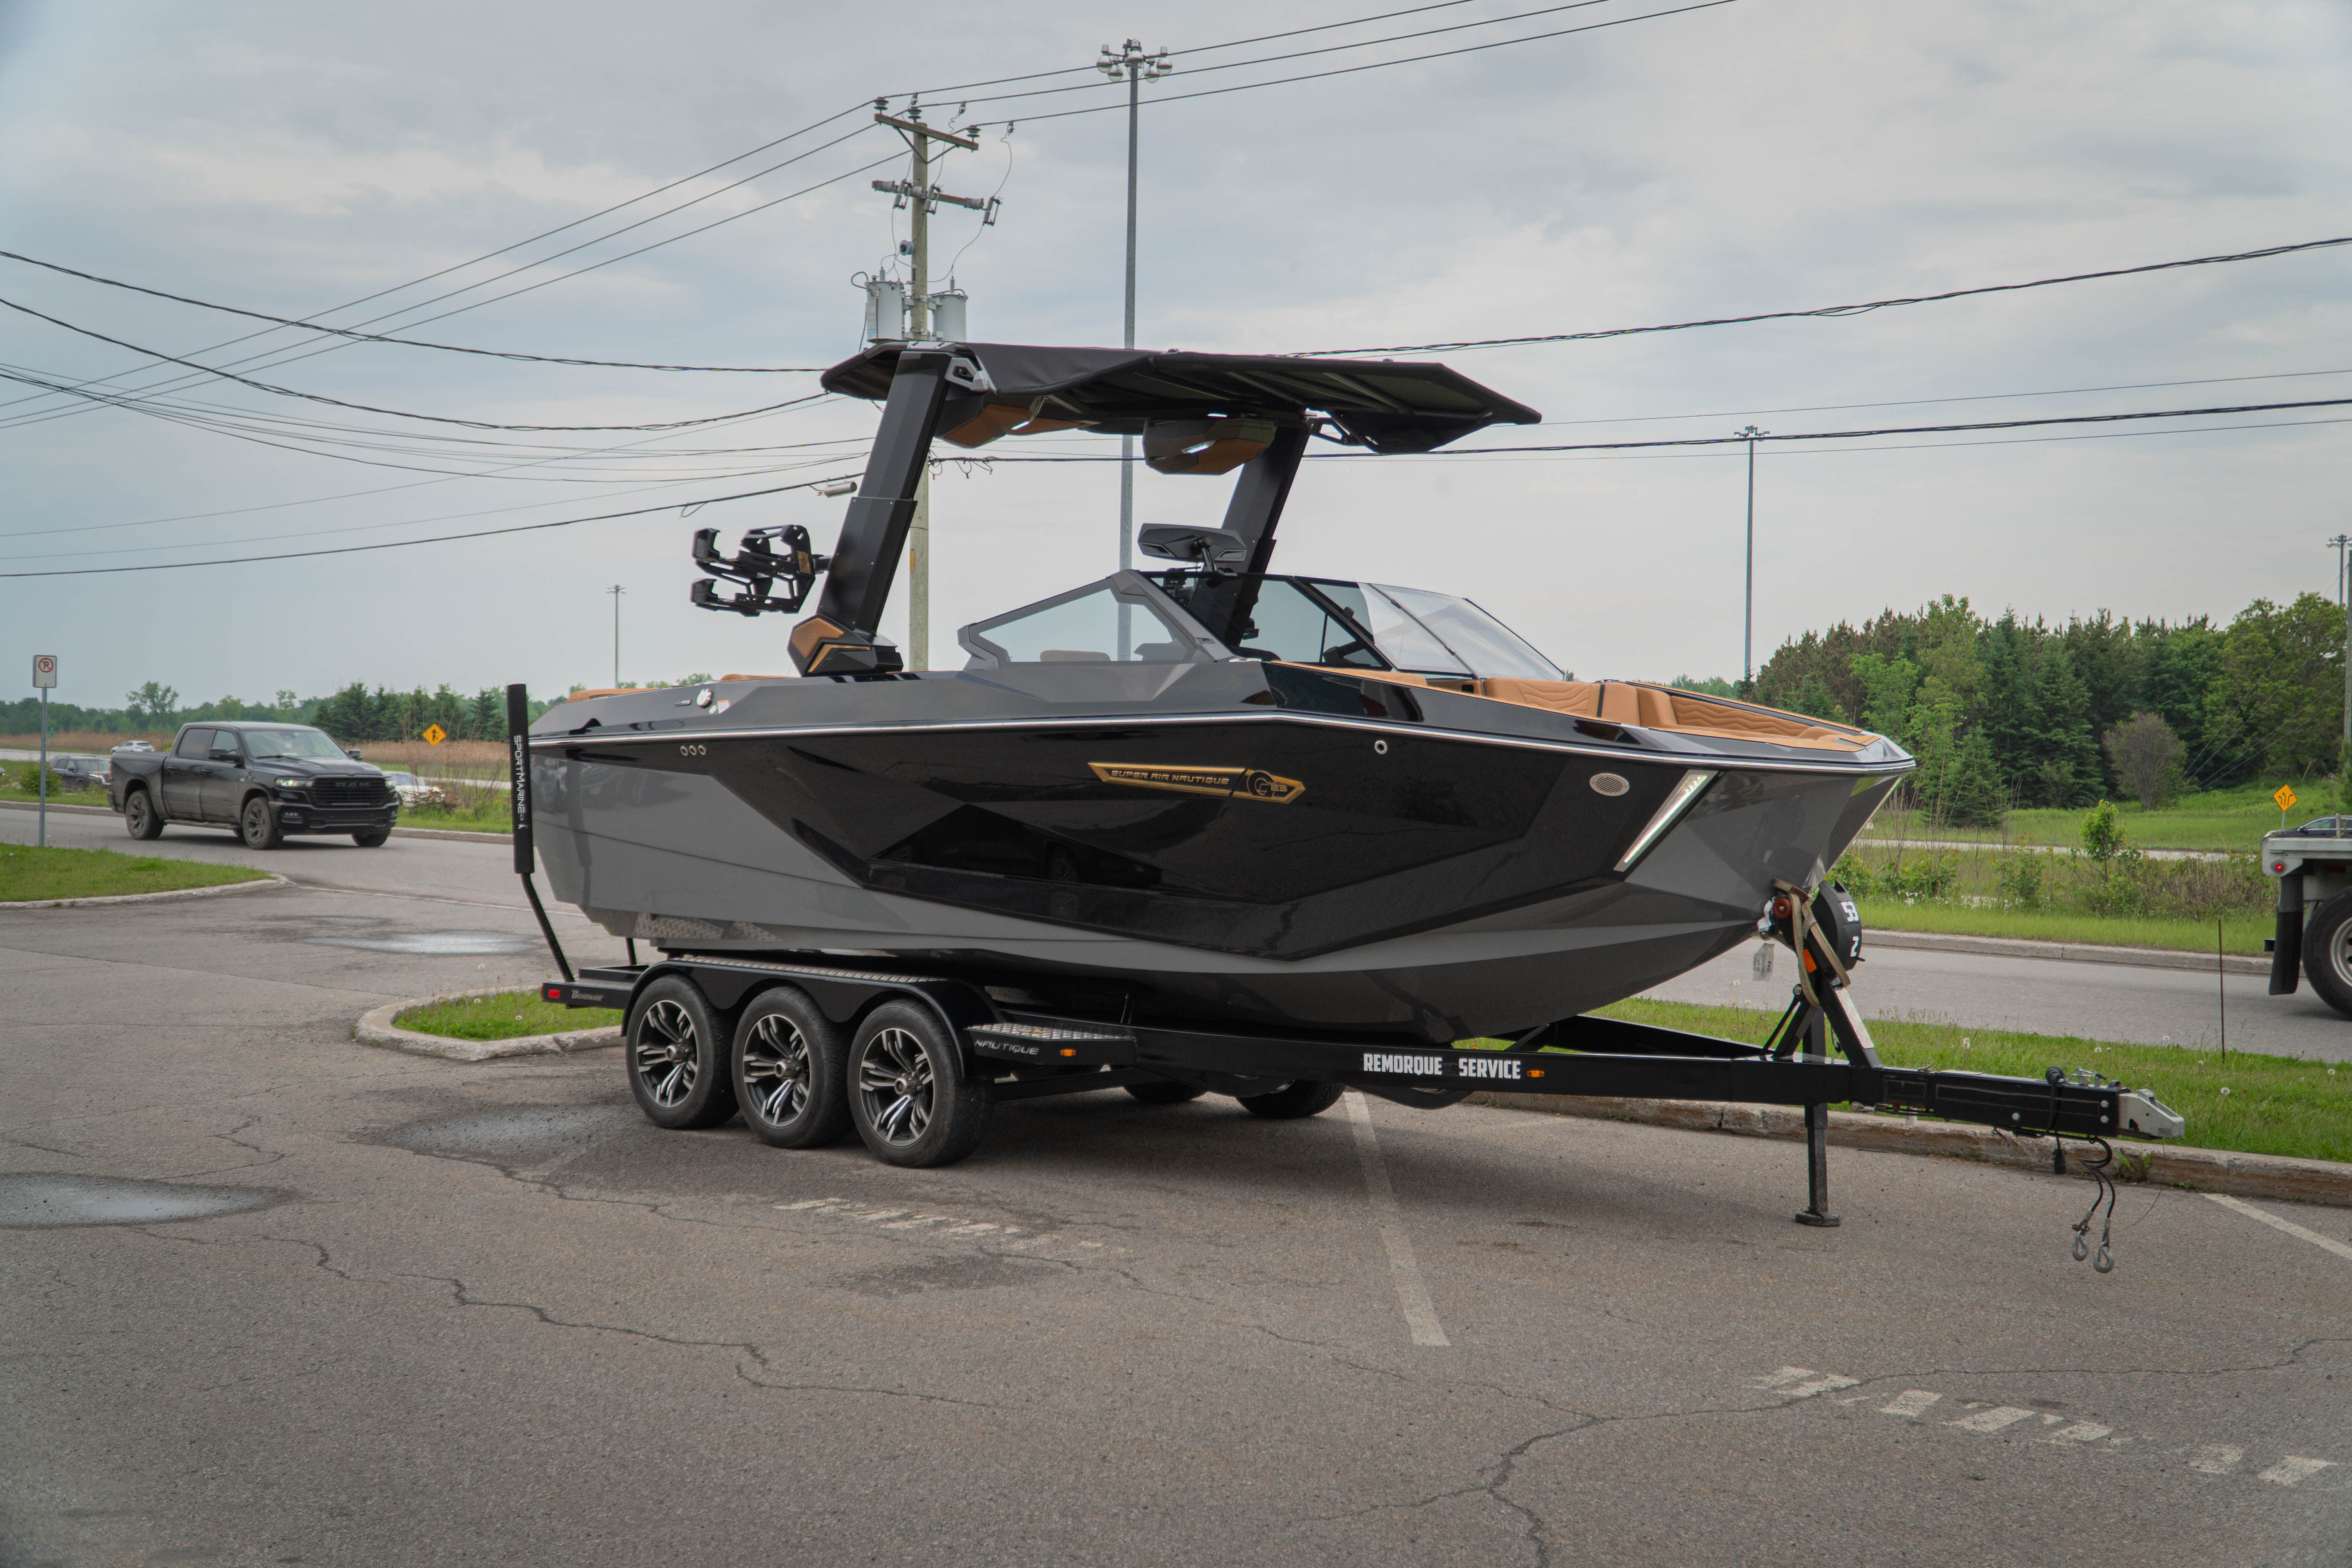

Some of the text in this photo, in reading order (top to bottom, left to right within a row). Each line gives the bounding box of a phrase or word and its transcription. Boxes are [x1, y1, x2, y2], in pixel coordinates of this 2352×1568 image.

[1111, 770, 1230, 784] SUPER AIR NAUTIQUE
[975, 1039, 1040, 1055] NAUTIQUE
[1363, 1053, 1521, 1079] REMORQUE SERVICE
